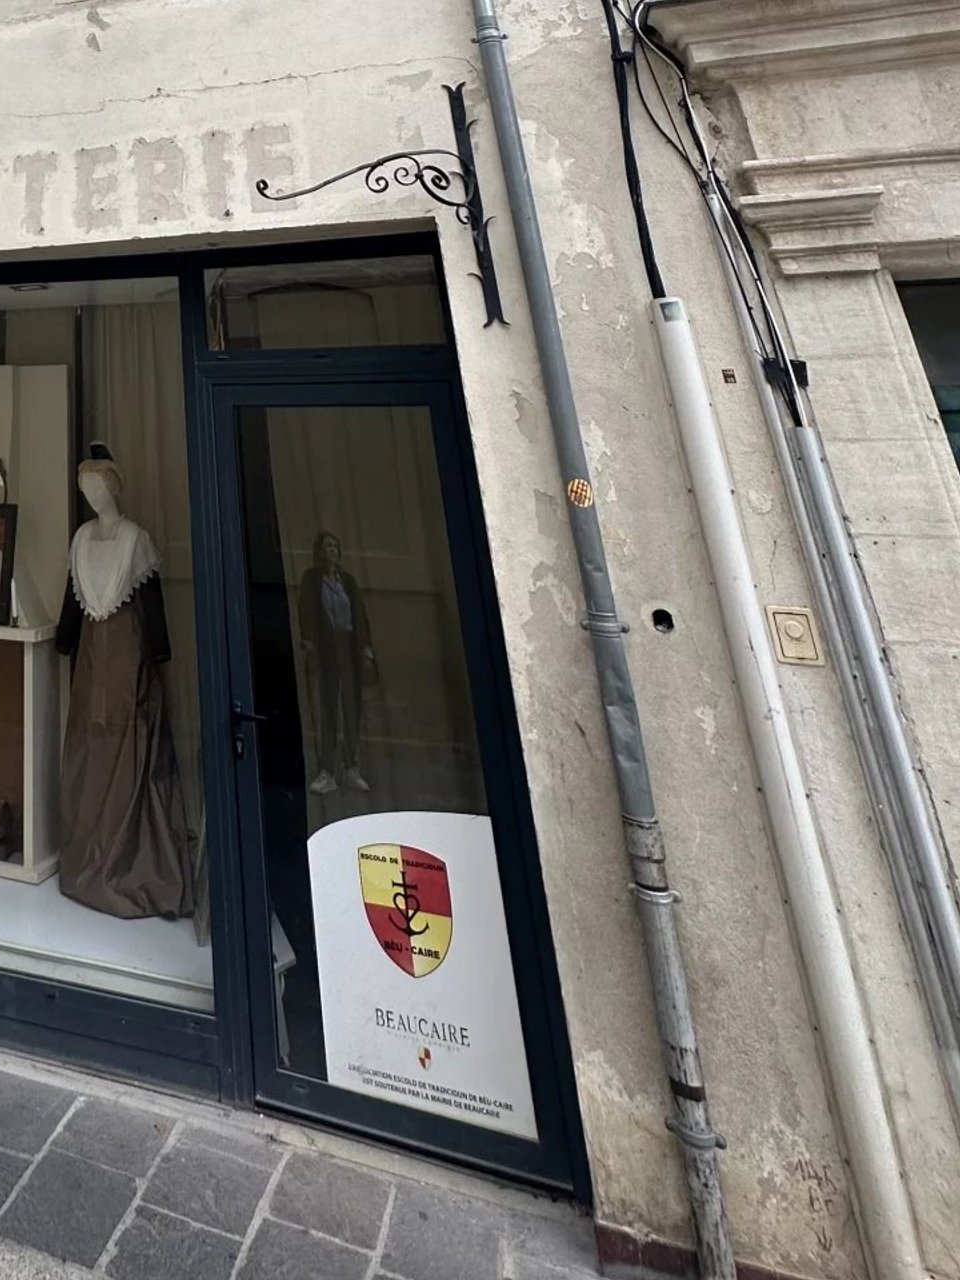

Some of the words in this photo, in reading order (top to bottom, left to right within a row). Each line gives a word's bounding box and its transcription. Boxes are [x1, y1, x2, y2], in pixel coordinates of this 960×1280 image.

[359, 852, 387, 863] ESCOLO
[389, 856, 399, 865] DE
[410, 945, 441, 960] CAIRE
[374, 1007, 471, 1047] BEAUCAIRE
[393, 1074, 418, 1087] ESCOLO
[418, 1080, 427, 1090] DE
[428, 1083, 468, 1100] TRADICIOUN
[469, 1093, 478, 1103] DE
[408, 1088, 420, 1098] PAR
[454, 1100, 463, 1110] DE
[463, 1102, 500, 1118] BEAUCAIRE
